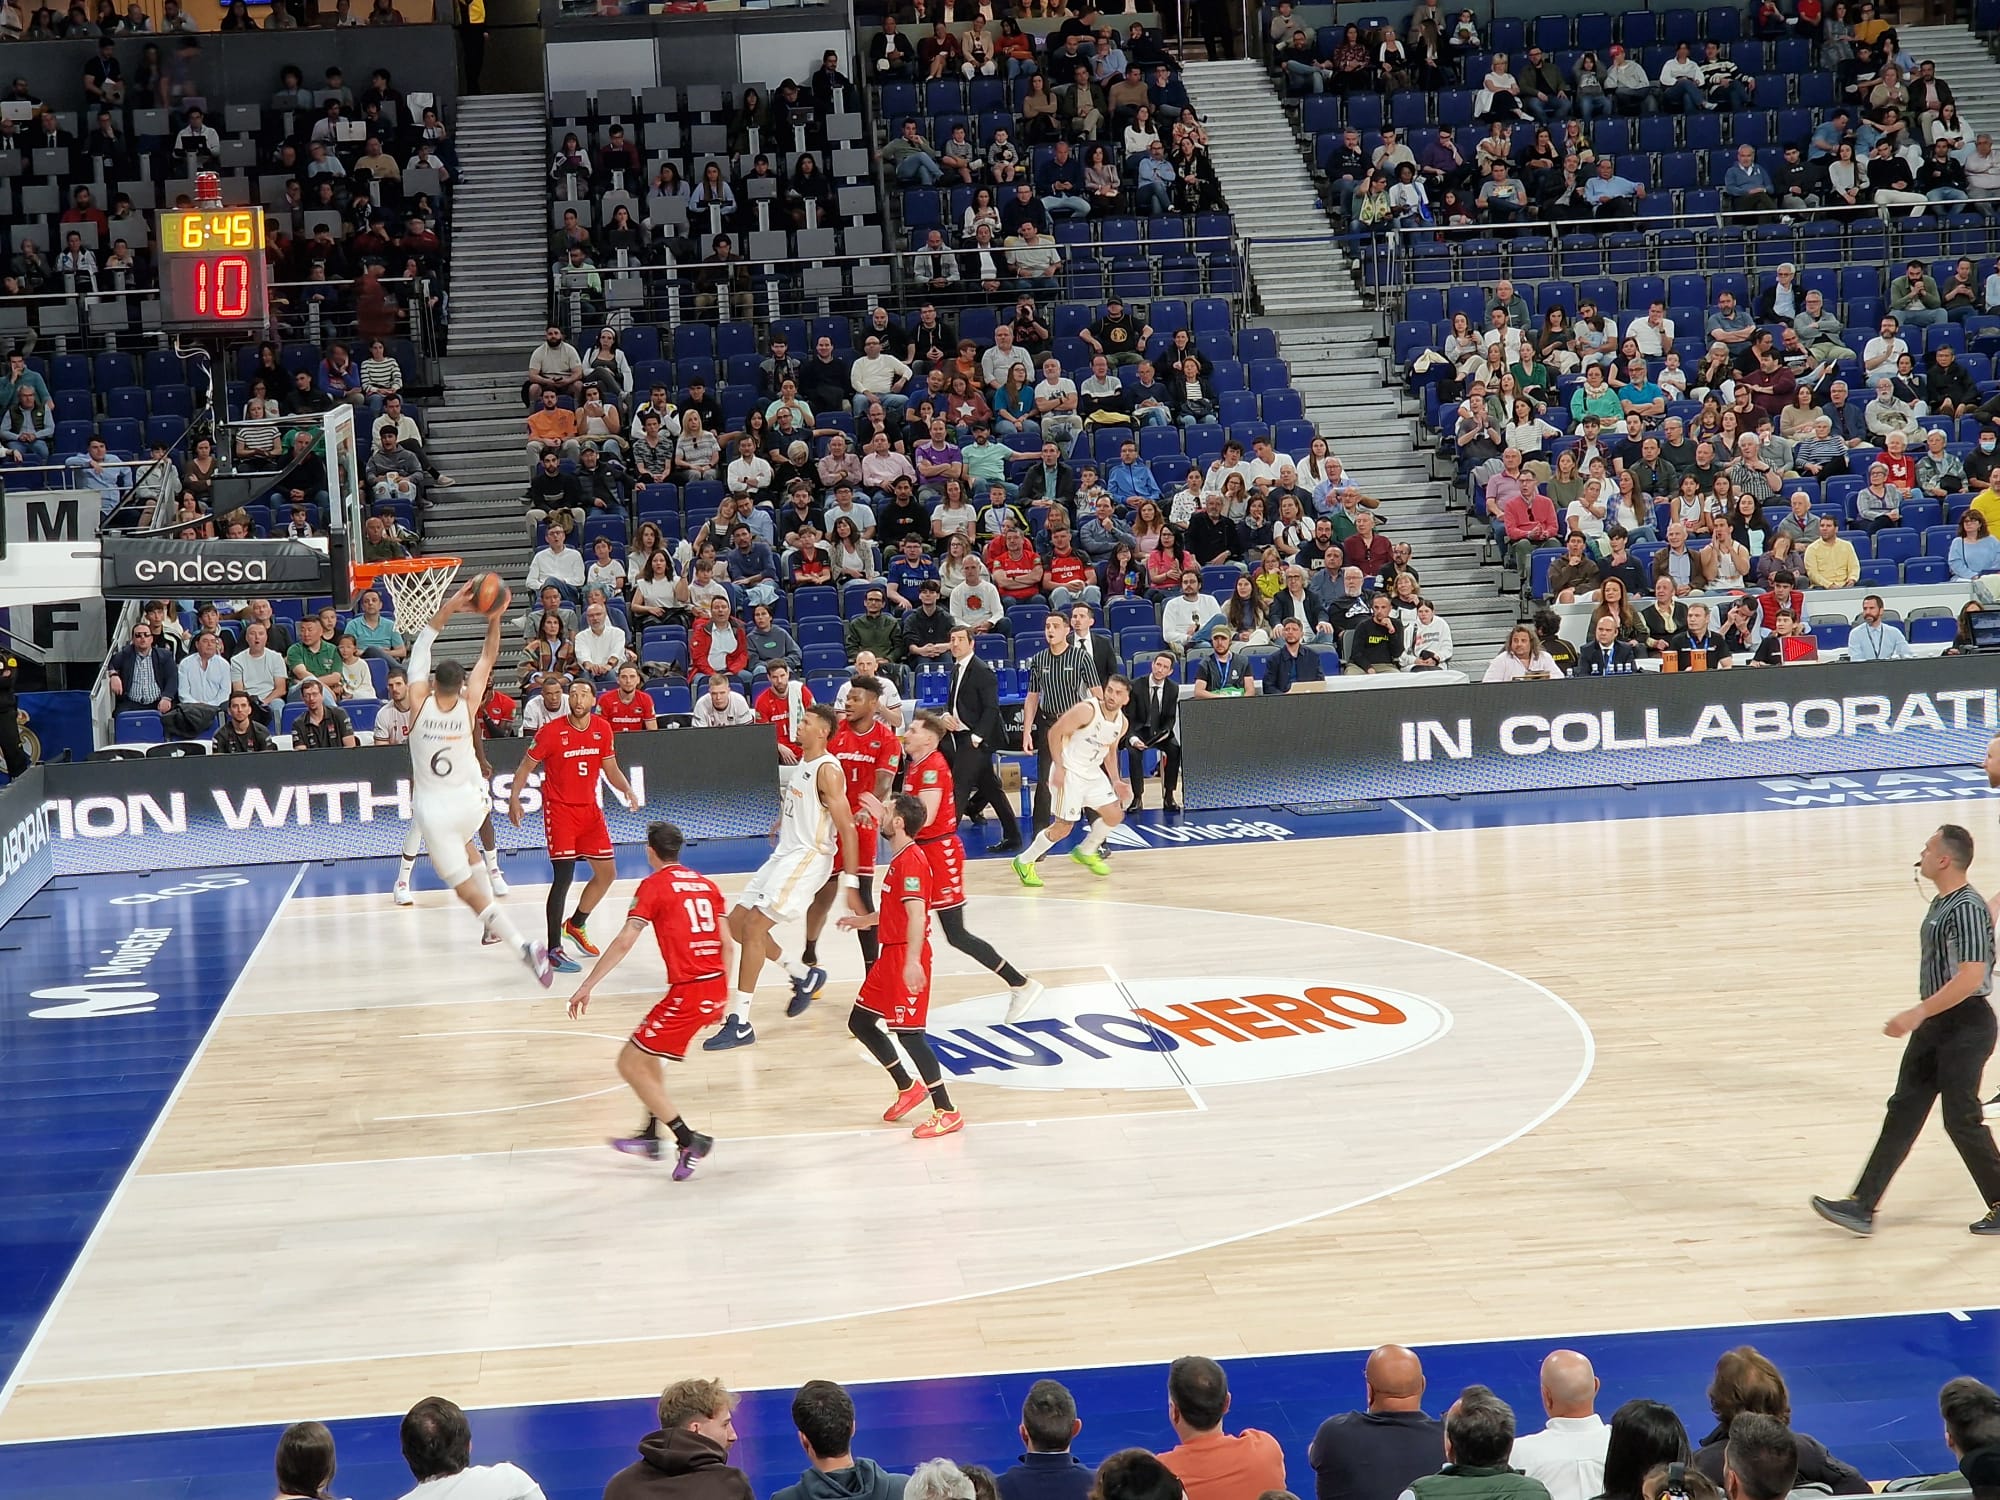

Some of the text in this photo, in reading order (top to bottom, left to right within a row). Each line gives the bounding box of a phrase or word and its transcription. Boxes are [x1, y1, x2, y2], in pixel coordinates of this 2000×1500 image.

[183, 215, 251, 248] 6:45
[199, 260, 248, 315] 10
[26, 500, 79, 542] M
[135, 555, 267, 582] endesa
[1004, 722, 1038, 733] Unica
[1401, 688, 1998, 761] IN COLLABORATI
[430, 746, 452, 777] 6
[578, 761, 588, 776] 5
[851, 767, 858, 782] 1
[211, 779, 413, 830] WITH
[1140, 818, 1295, 841] Unicaja
[683, 898, 716, 933] 19
[83, 927, 172, 977] Movistar
[927, 987, 1407, 1075] AUTOHERO
